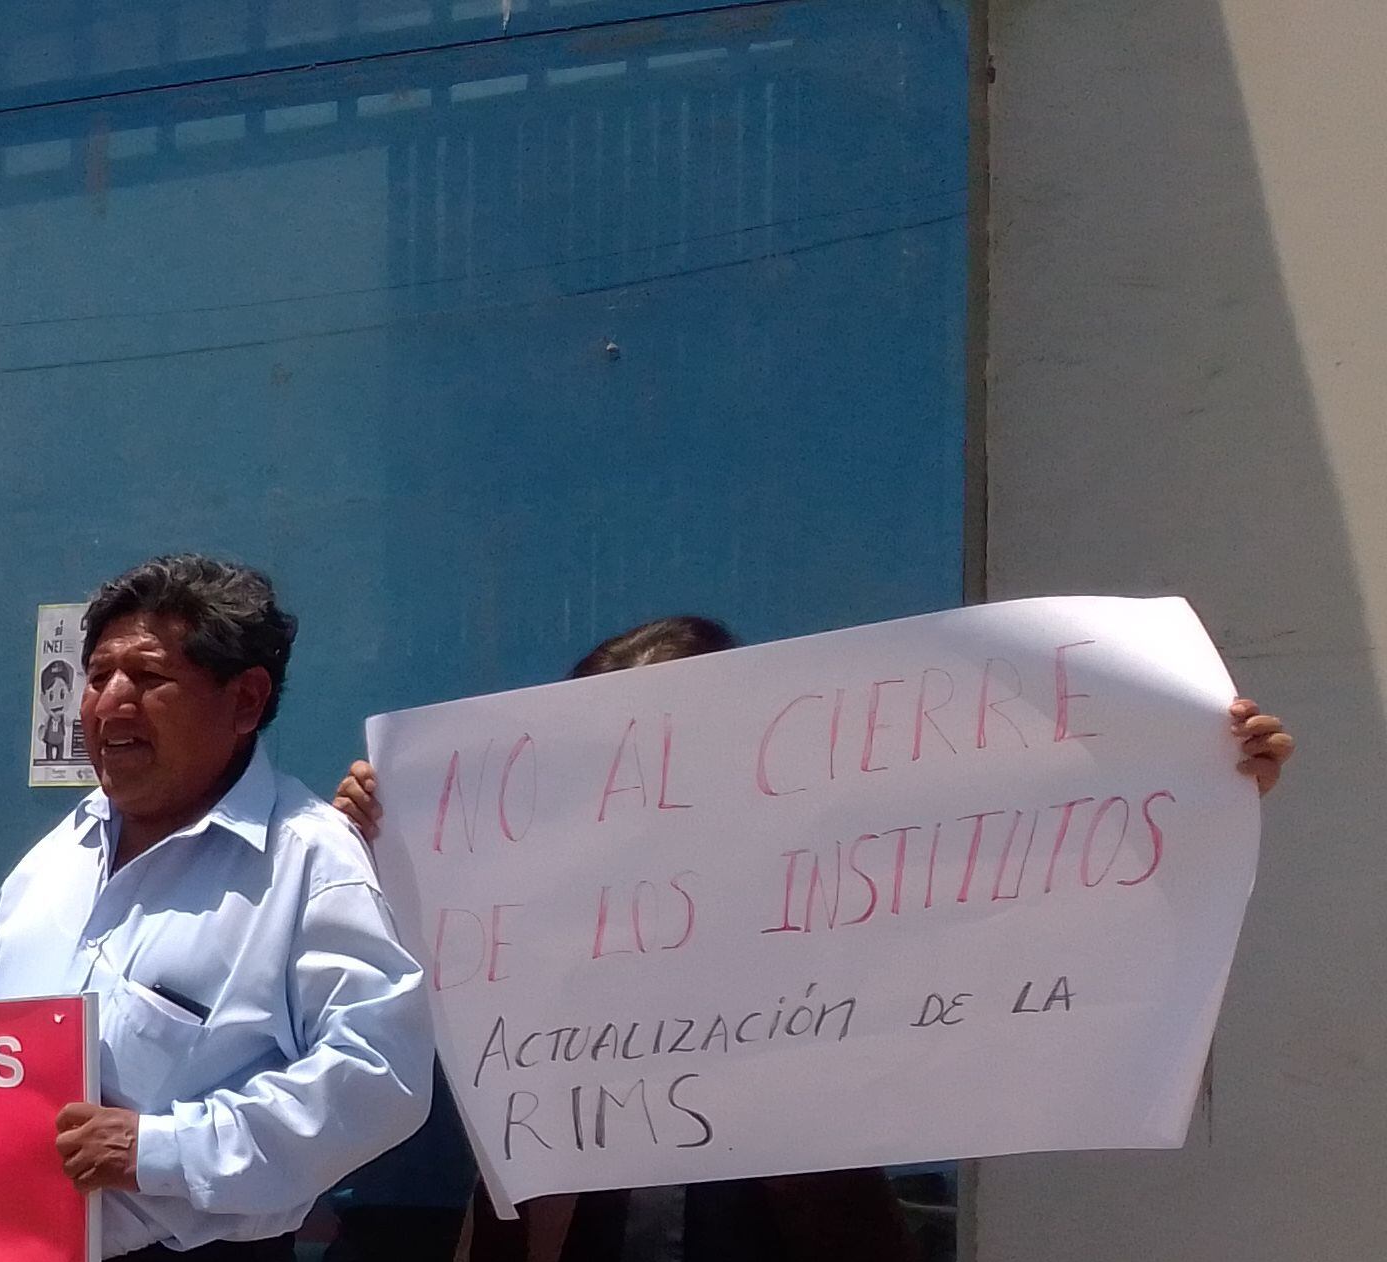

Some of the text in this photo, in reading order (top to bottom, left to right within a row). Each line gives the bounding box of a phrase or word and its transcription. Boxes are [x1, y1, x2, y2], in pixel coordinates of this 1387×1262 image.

[432, 638, 1101, 856] NO AL CIERRE
[432, 788, 1177, 992] DE LOS INSTITUTOS
[910, 991, 975, 1030] DE
[1011, 975, 1078, 1016] LA
